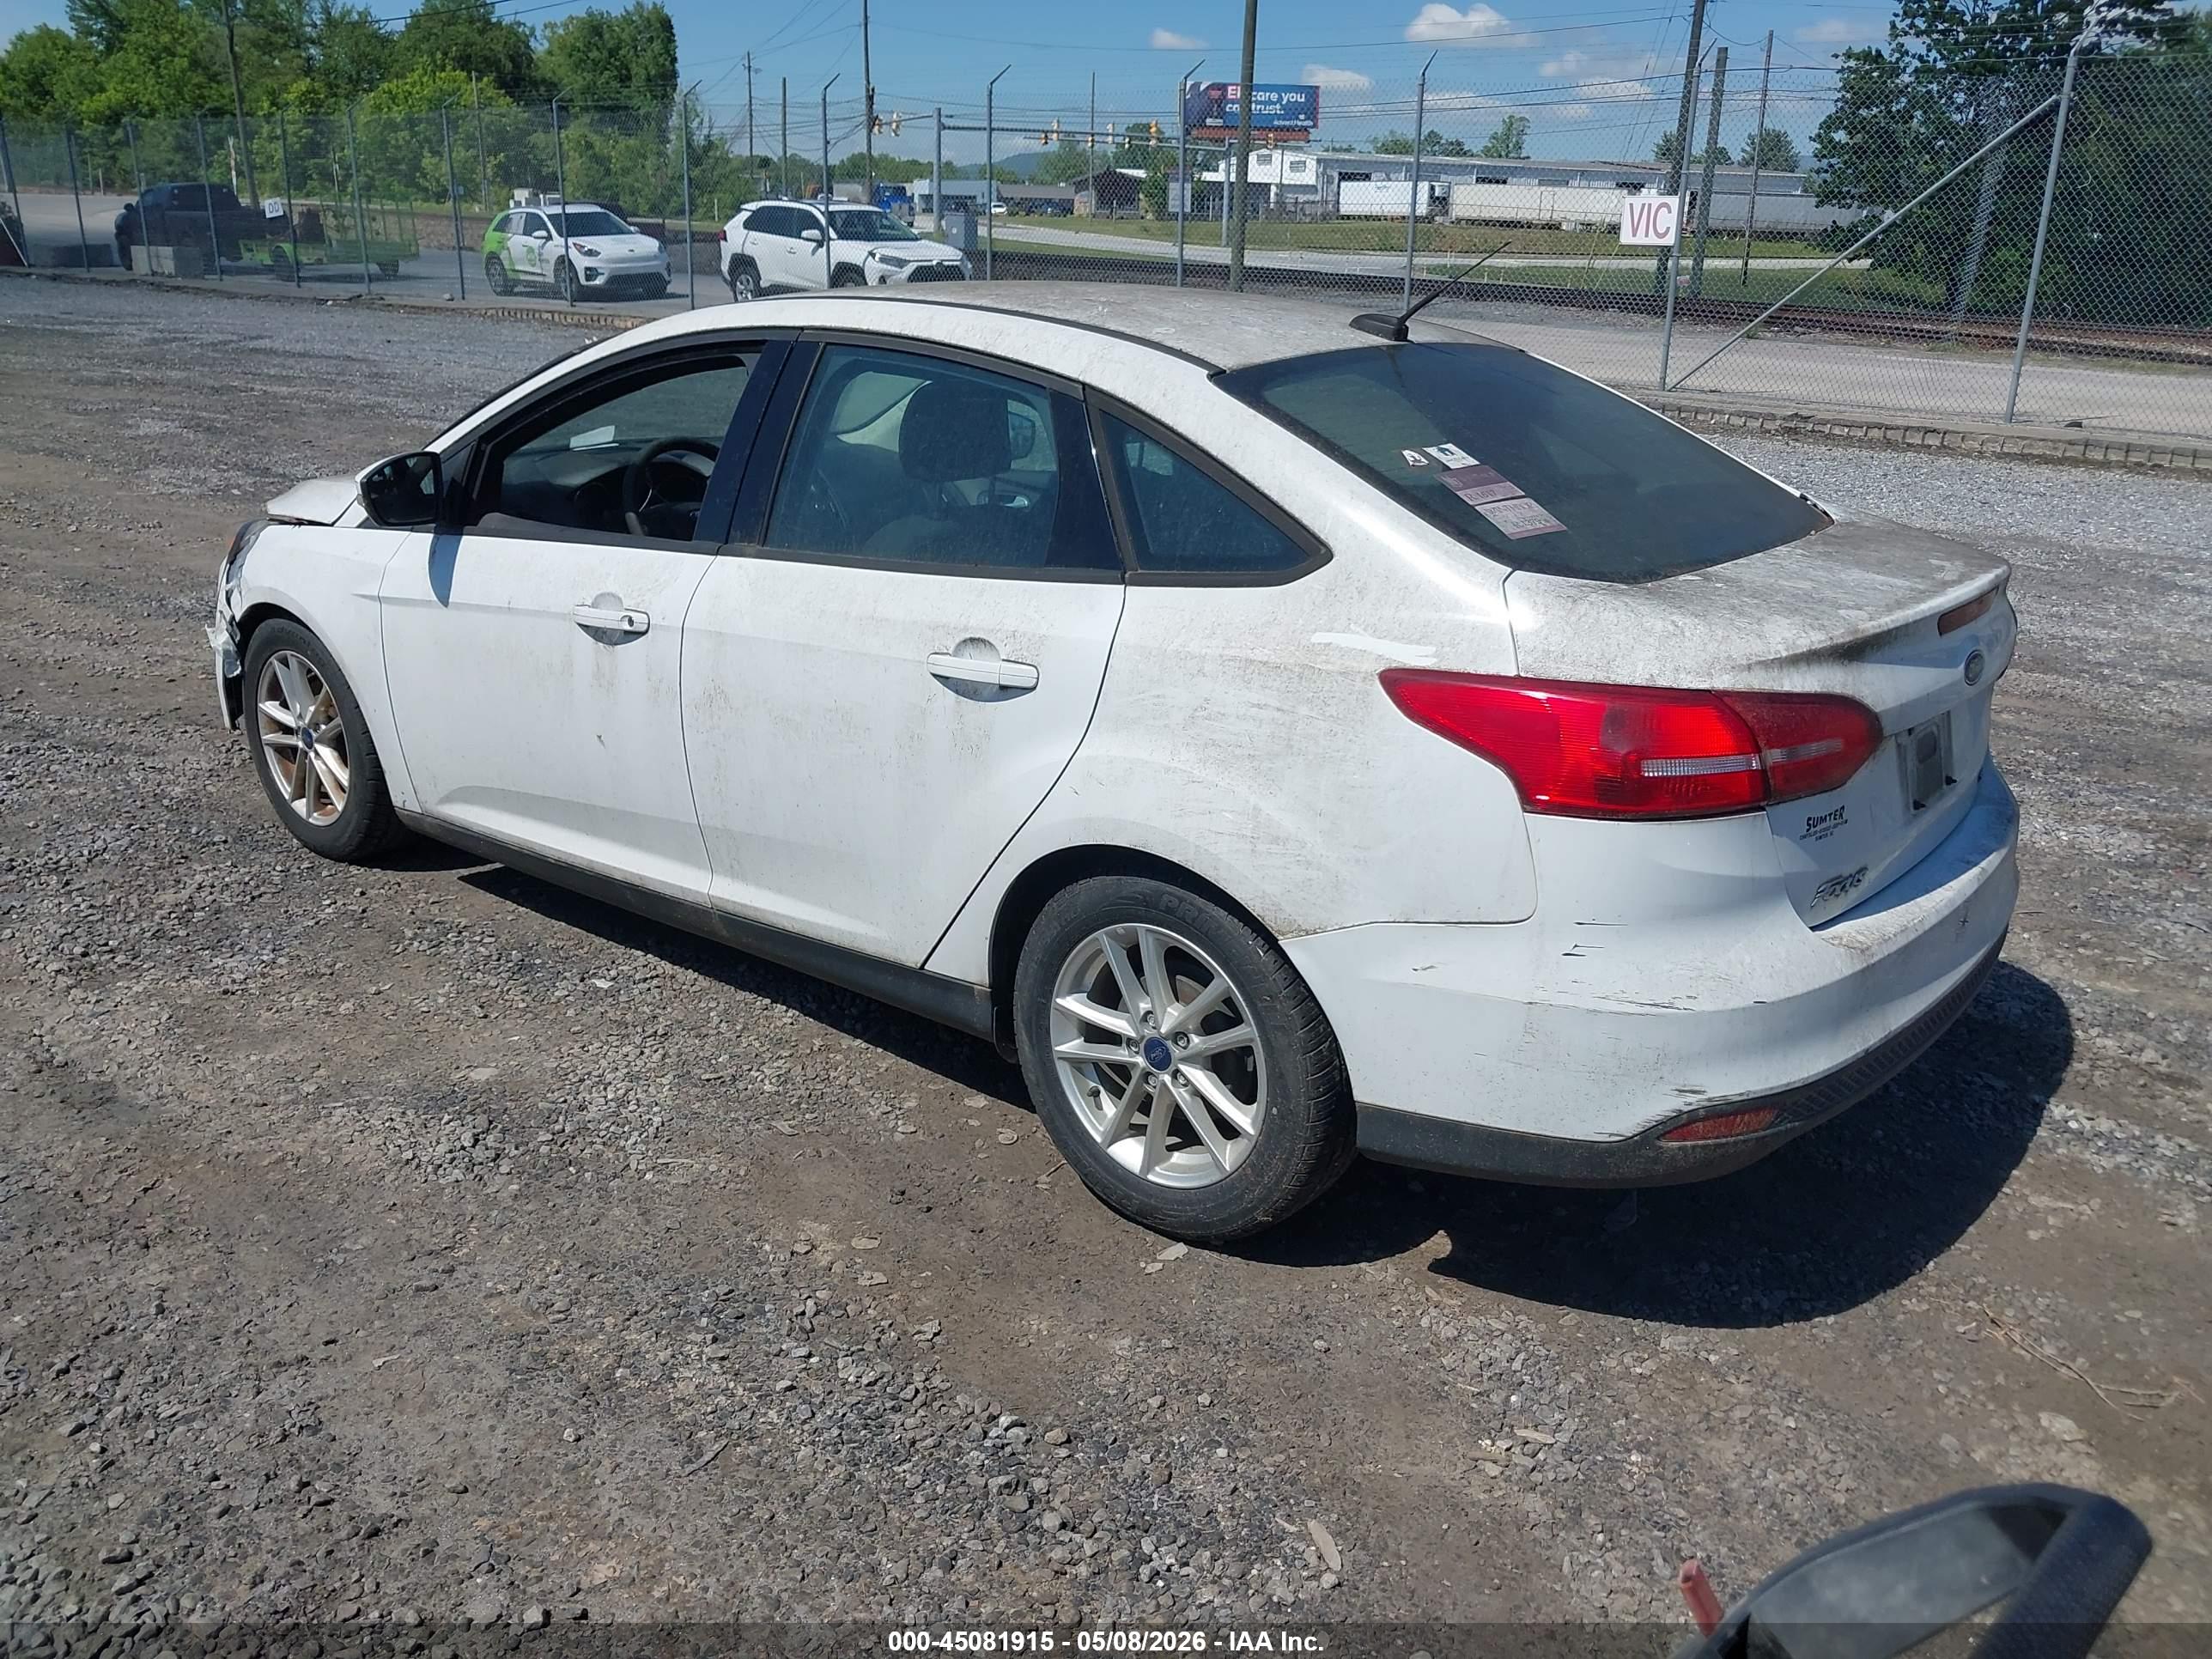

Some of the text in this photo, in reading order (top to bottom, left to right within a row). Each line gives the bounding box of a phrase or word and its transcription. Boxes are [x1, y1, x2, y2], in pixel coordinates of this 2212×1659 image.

[1281, 92, 1305, 105] you
[1628, 202, 1672, 239] VIC
[1806, 805, 1845, 833] SUMTER
